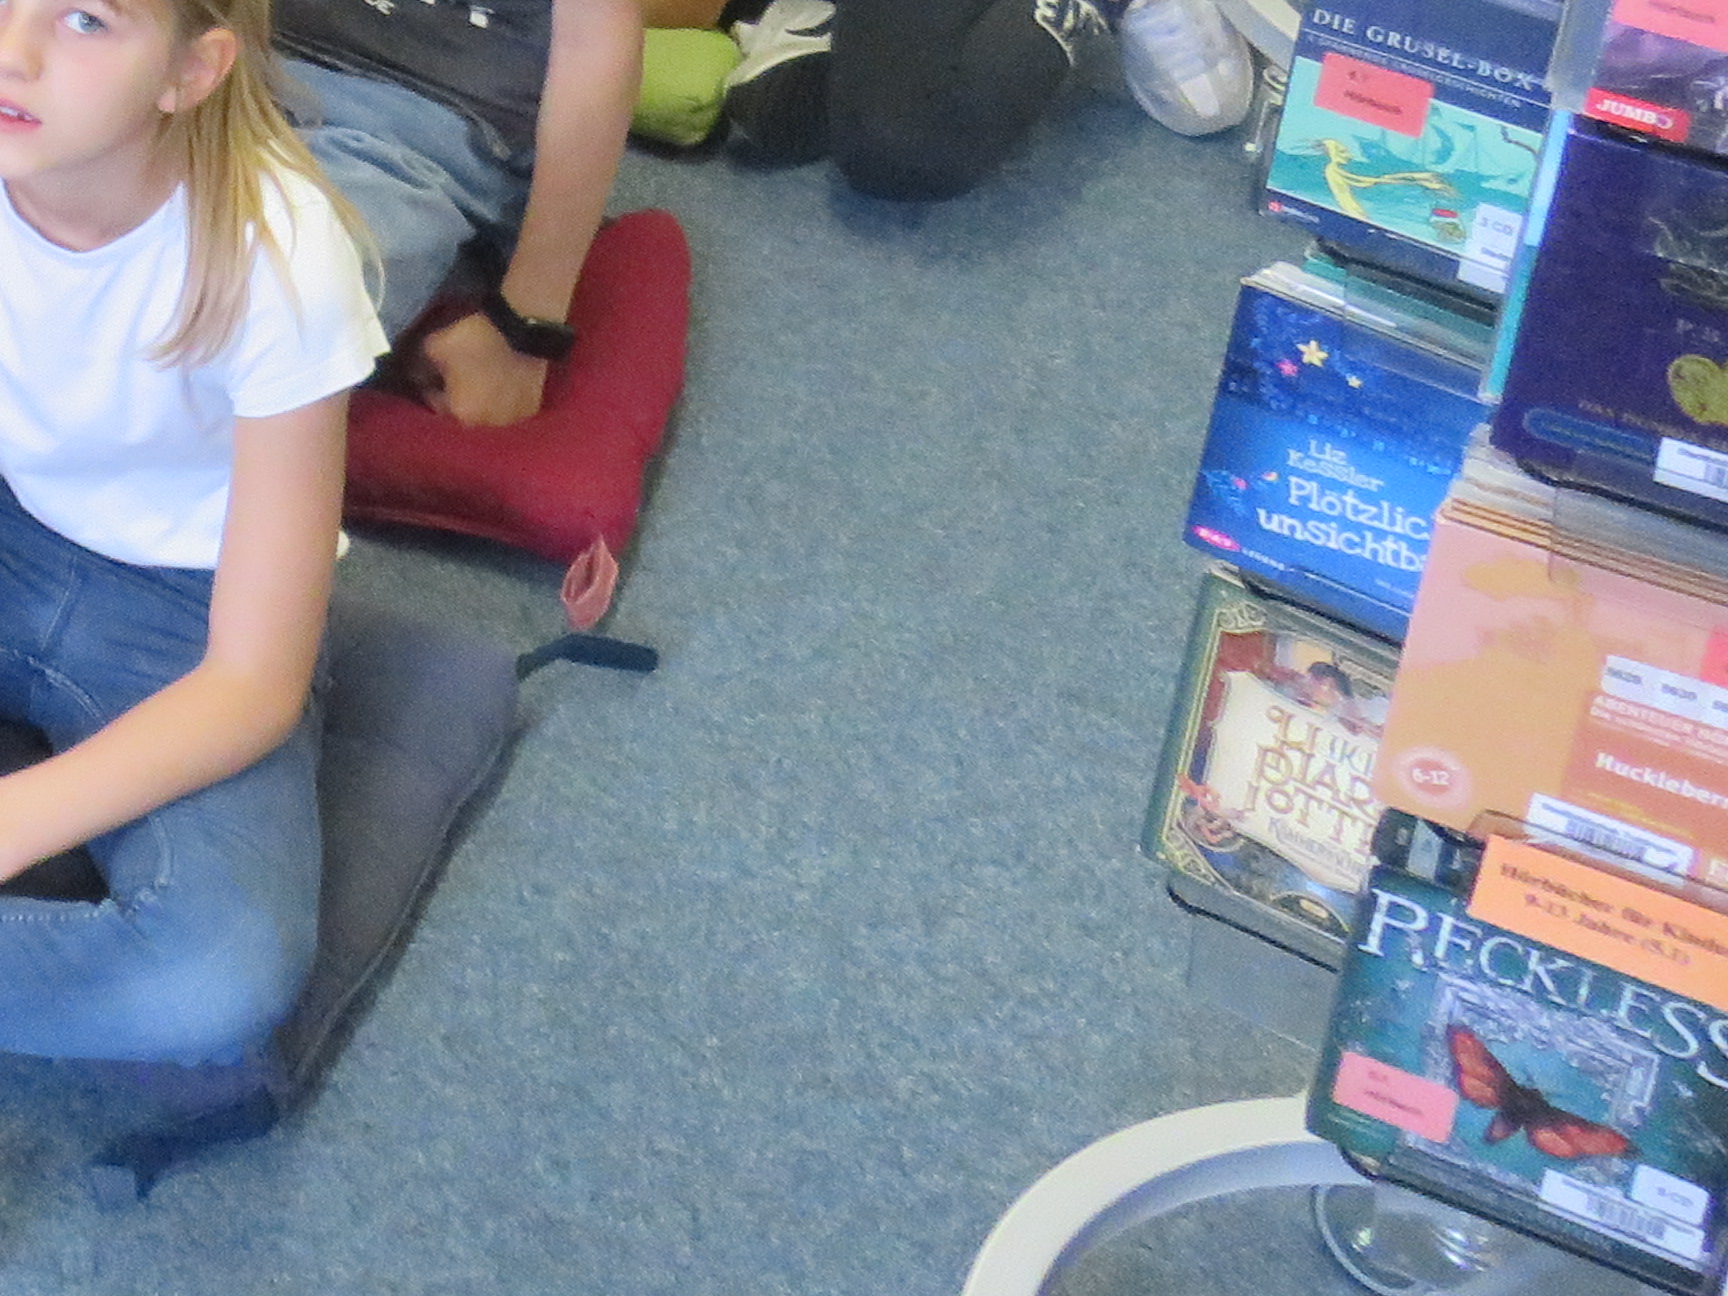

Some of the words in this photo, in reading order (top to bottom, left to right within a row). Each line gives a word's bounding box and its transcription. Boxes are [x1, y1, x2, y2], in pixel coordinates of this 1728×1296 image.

[1312, 8, 1357, 36] DIE
[1365, 24, 1535, 92] GRUSEL-BOX
[1595, 98, 1675, 130] JUMBO
[1286, 448, 1385, 493] Kessler
[1309, 439, 1347, 465] Liz
[1288, 475, 1431, 540] Plötzlic
[1256, 506, 1428, 573] unsichtb
[1412, 768, 1450, 786] 6-12
[1357, 887, 1728, 1092] RECKLESS
